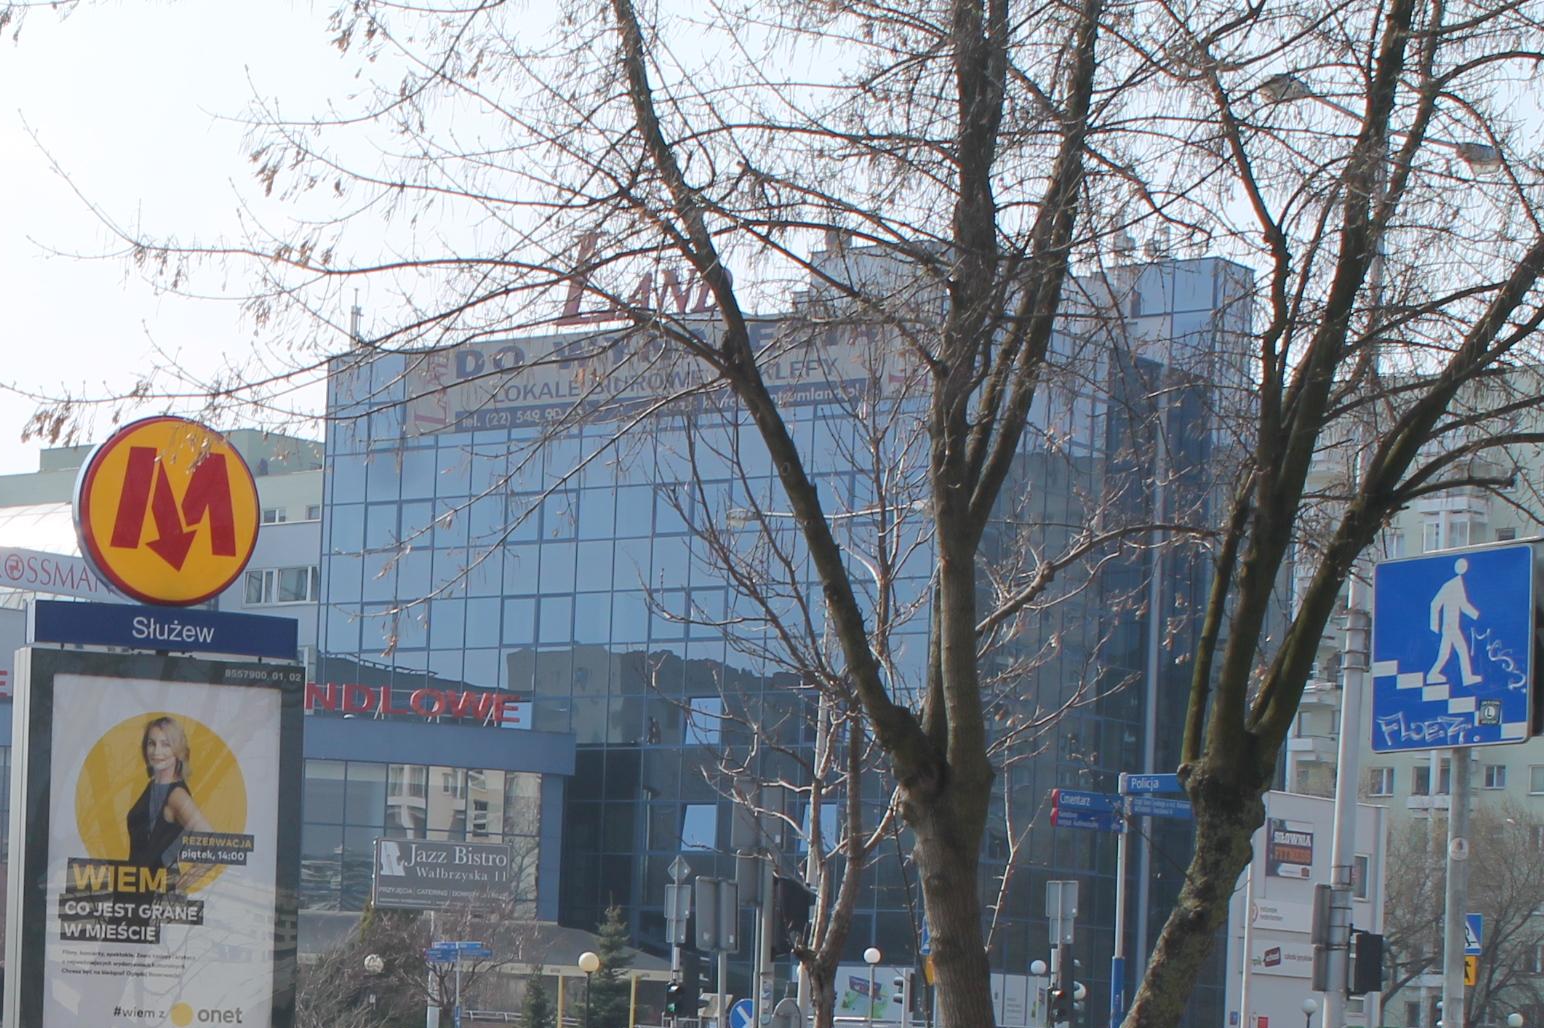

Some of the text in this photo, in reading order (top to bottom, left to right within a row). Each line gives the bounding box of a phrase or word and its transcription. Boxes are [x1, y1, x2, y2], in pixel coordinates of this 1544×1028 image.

[455, 344, 525, 378] DO
[494, 379, 582, 403] LOKALE
[485, 411, 511, 427] (22)
[132, 616, 215, 643] Służew
[289, 673, 302, 682] 02
[304, 682, 521, 724] NDLOWE
[1131, 778, 1159, 791] Policja
[1060, 793, 1091, 806] Cmentarz
[182, 836, 252, 849] REZERWACJA
[1274, 831, 1312, 847] SIŁOWNIA
[181, 850, 244, 862] piątek, 14:00
[405, 844, 507, 867] Jazz Bistro
[72, 863, 168, 894] WIEM
[416, 866, 488, 882] Wałbrzyska
[64, 901, 198, 921] CO JEST GRANE
[64, 921, 156, 941] W MIEŚCIE
[113, 1005, 166, 1018] #wiem z
[197, 1007, 243, 1024] onet
